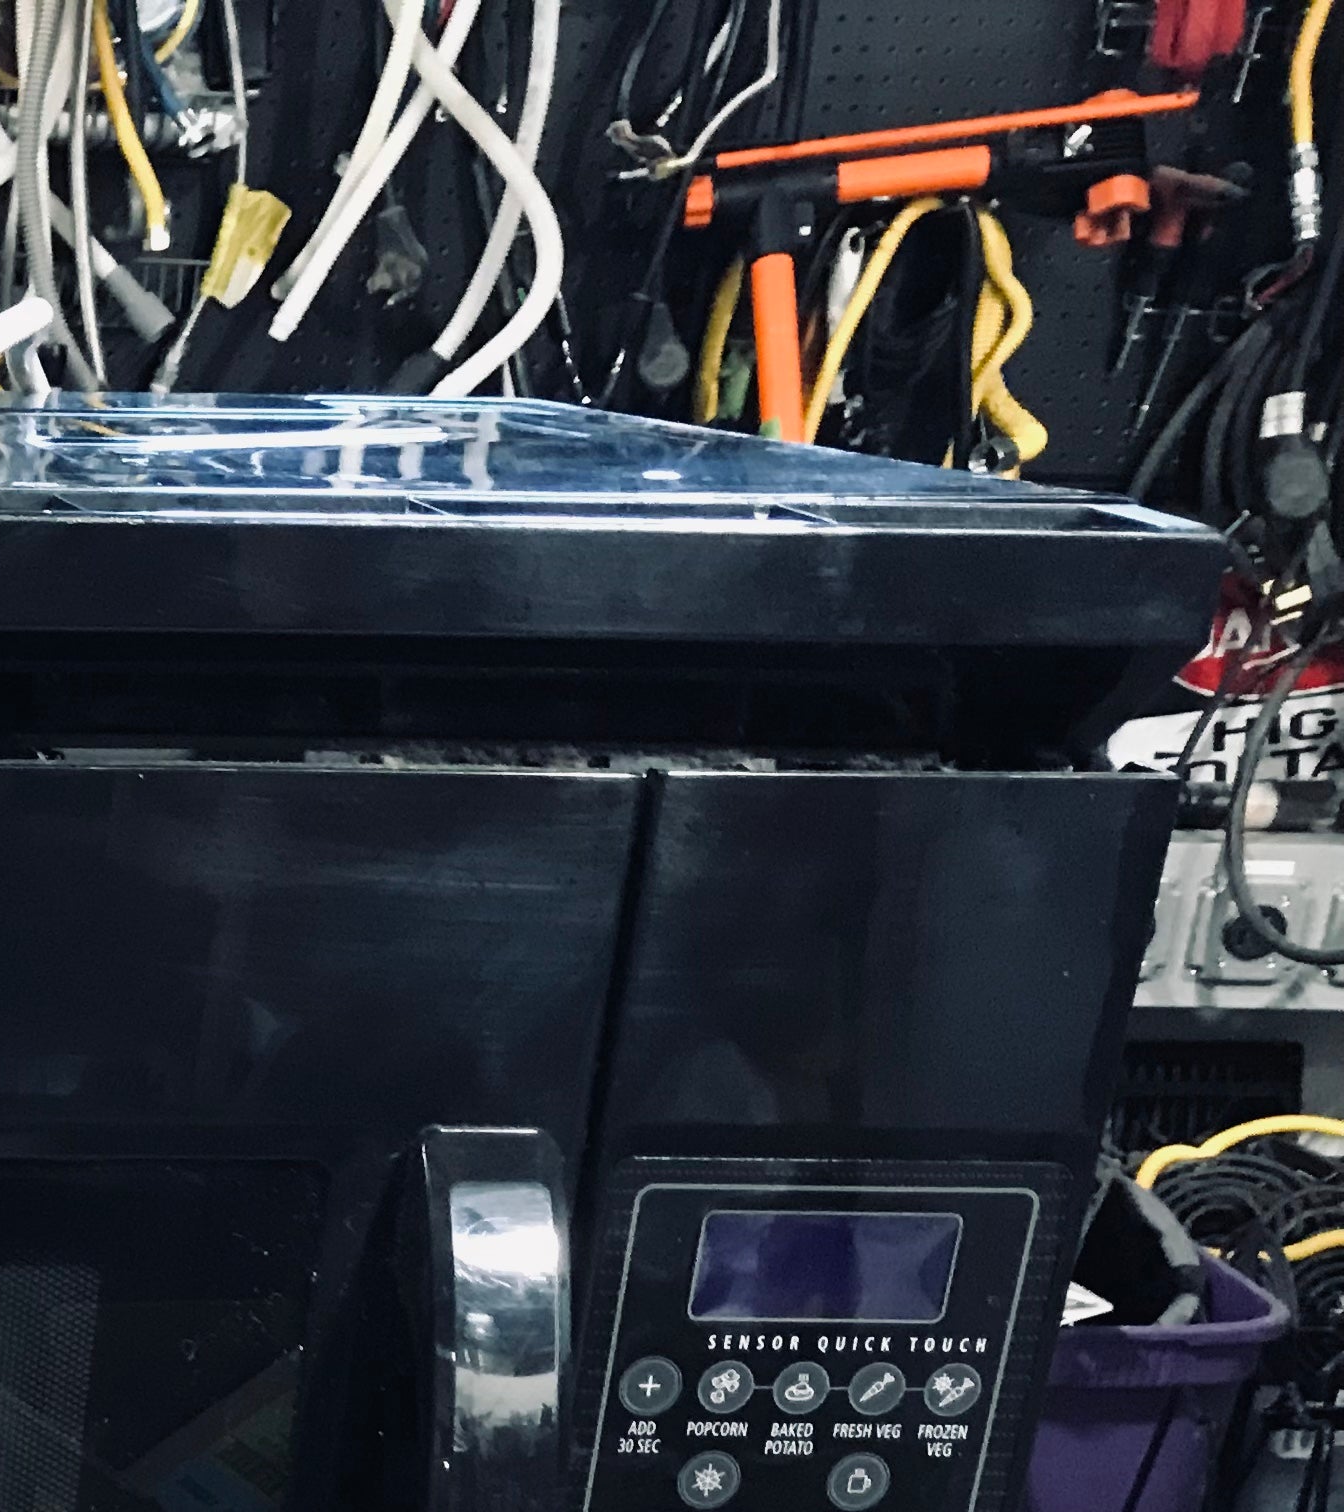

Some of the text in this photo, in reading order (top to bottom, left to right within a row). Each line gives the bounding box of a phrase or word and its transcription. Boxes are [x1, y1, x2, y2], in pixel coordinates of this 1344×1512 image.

[707, 1334, 987, 1353] SENSOR QUICK TOUCH
[627, 1420, 657, 1436] ADD
[686, 1421, 749, 1437] POPCORN
[770, 1422, 814, 1438] BAKED
[832, 1422, 902, 1439] FRESH VEG
[917, 1424, 969, 1440] FROZEN
[617, 1437, 661, 1454] 30 SEC
[764, 1439, 814, 1456] POTATO
[927, 1441, 953, 1458] VEG
